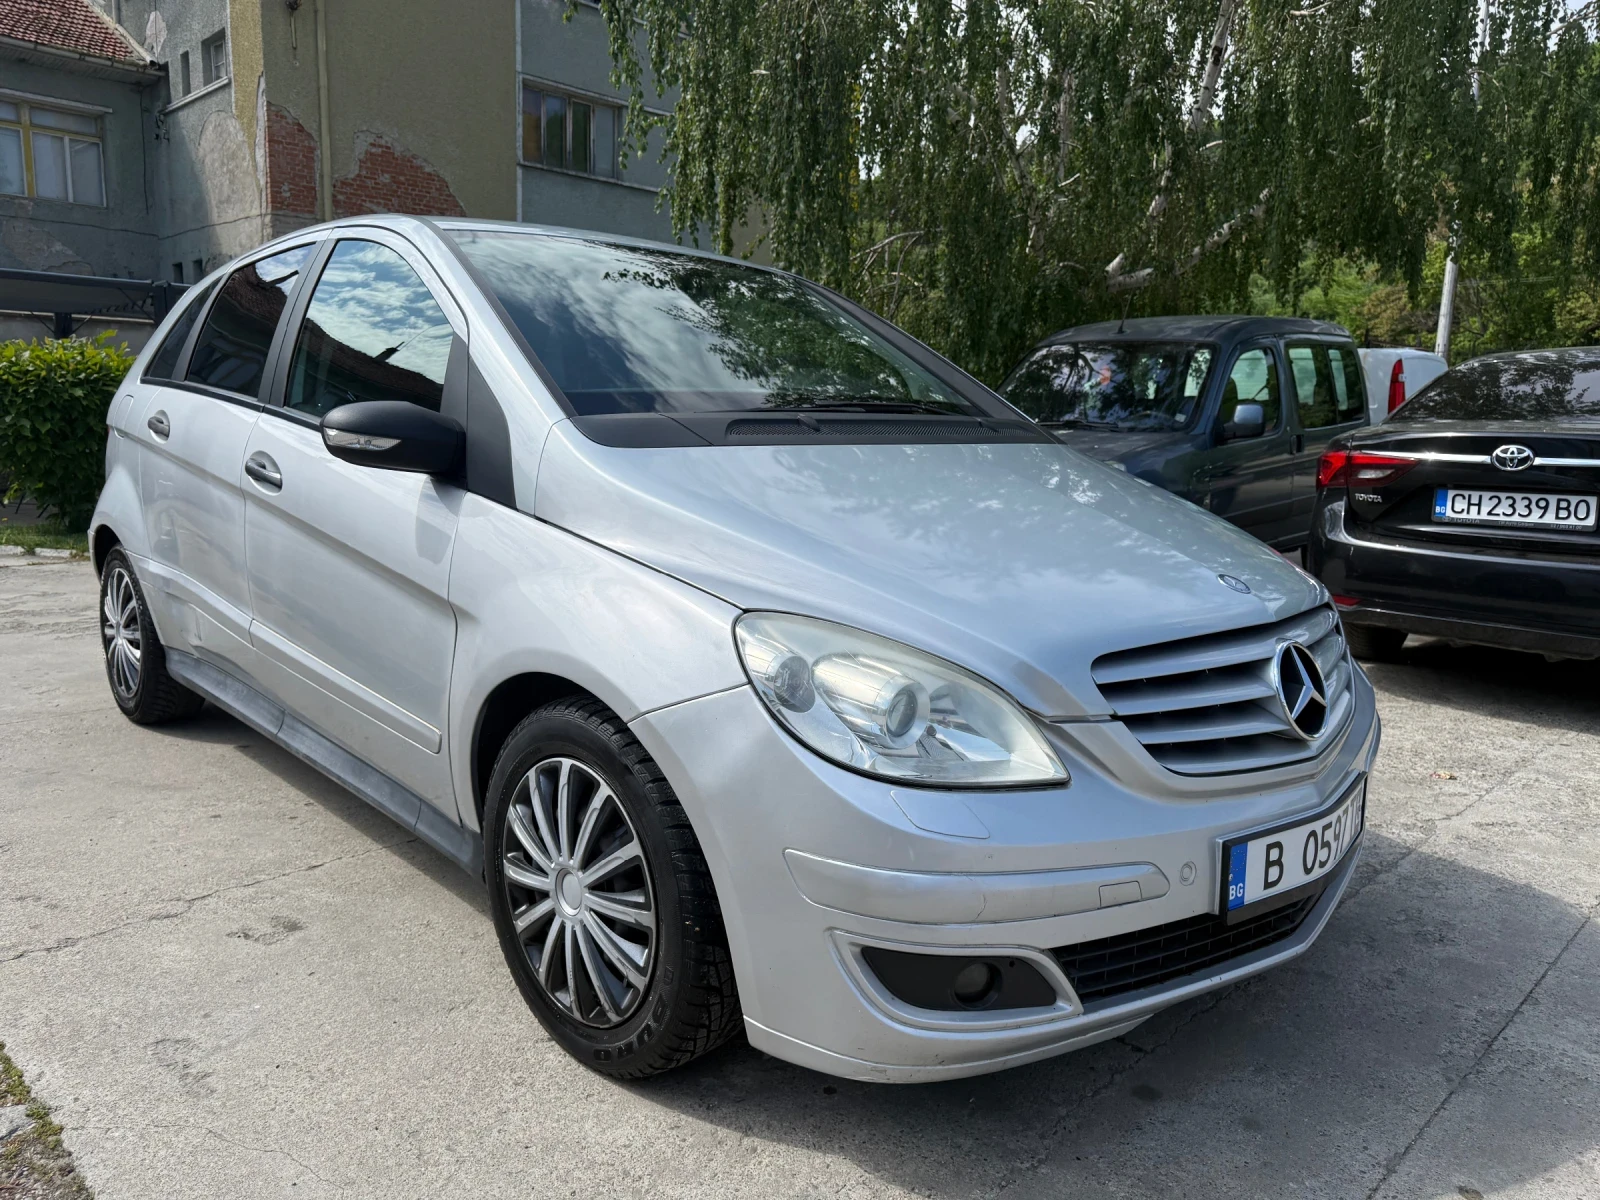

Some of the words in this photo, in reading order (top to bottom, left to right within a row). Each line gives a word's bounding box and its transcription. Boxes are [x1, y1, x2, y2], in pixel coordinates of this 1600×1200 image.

[1355, 493, 1382, 502] TOYOTA
[1451, 493, 1482, 515] CH
[1486, 495, 1550, 519] 2339
[1435, 506, 1446, 514] BG
[1263, 840, 1284, 891] B
[1302, 807, 1349, 875] 0597
[1229, 882, 1244, 900] BG
